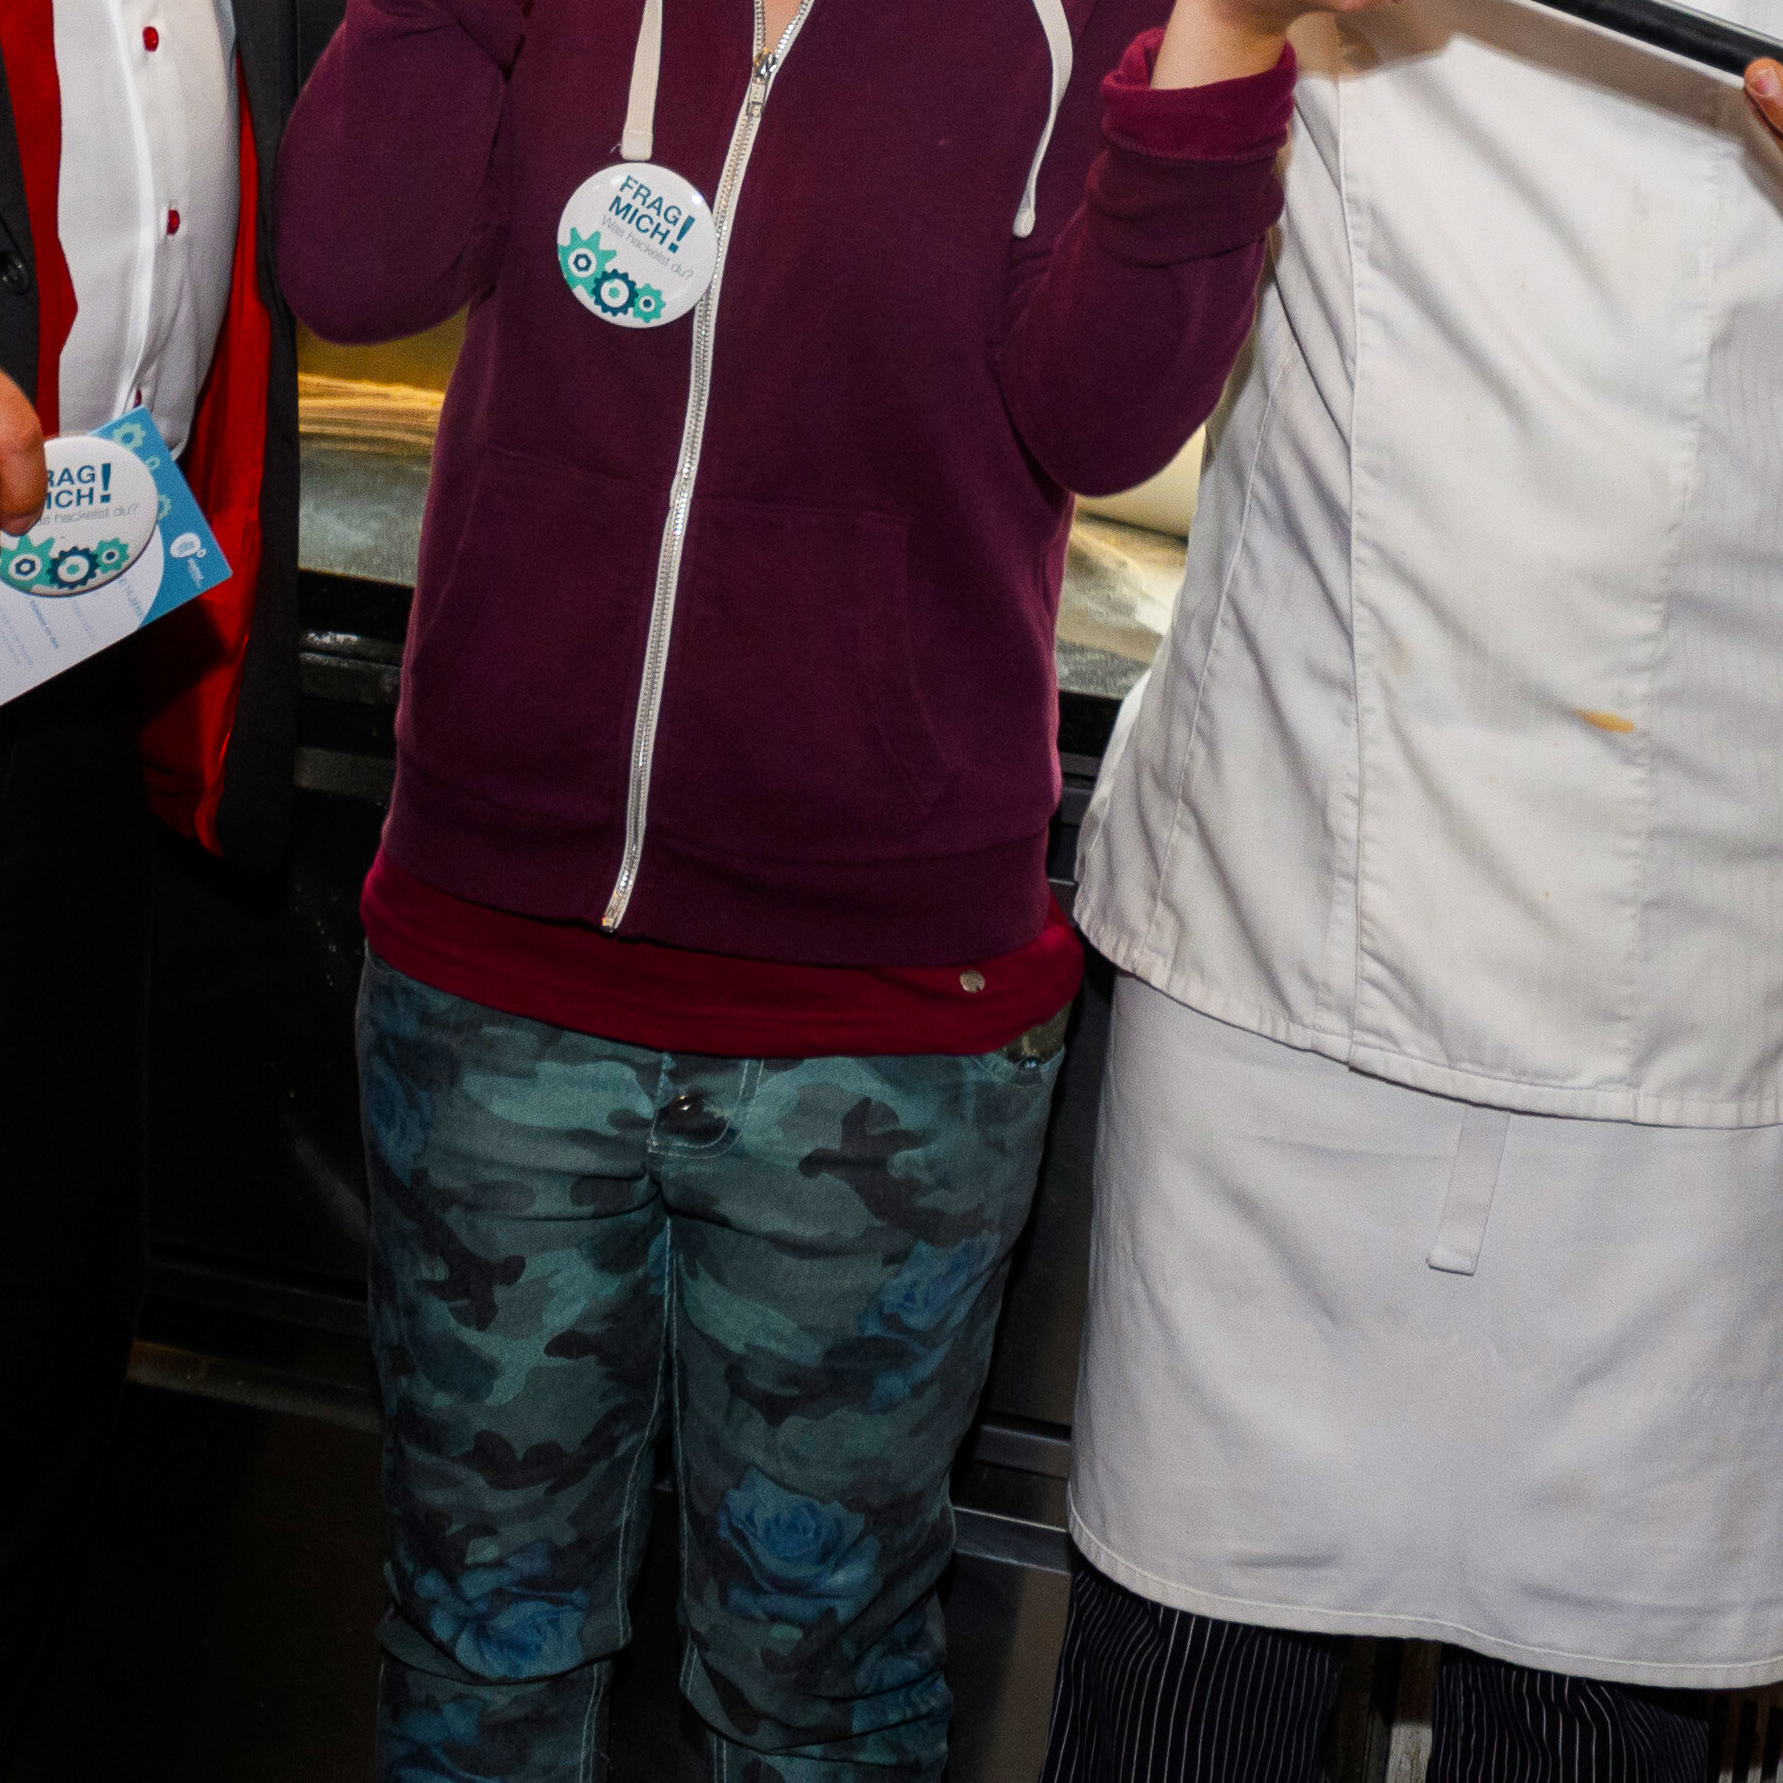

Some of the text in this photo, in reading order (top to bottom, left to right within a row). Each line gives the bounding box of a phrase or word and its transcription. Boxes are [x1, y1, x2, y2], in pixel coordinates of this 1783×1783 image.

[619, 174, 683, 228] FRAG
[45, 462, 112, 510] ICH!
[47, 464, 96, 488] RAG
